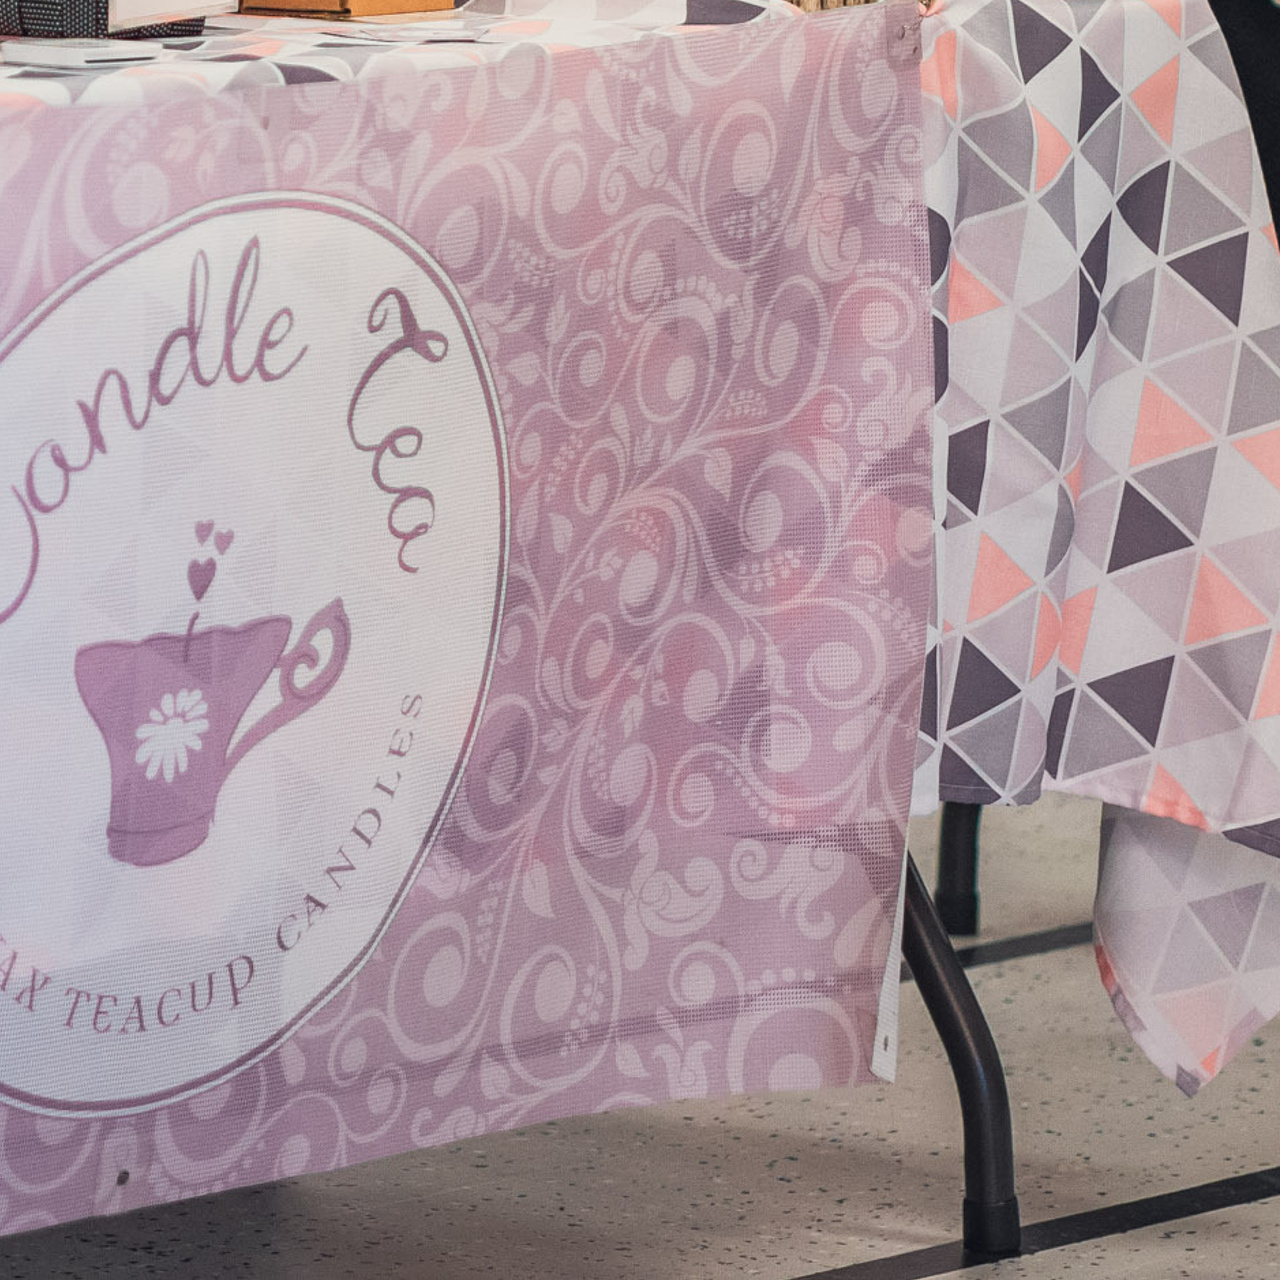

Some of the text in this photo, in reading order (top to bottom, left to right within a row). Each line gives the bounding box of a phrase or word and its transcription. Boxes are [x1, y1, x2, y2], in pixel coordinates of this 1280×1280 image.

[347, 286, 450, 575] Tea
[63, 953, 257, 1036] TEACUP
[275, 691, 425, 955] CANDLES
